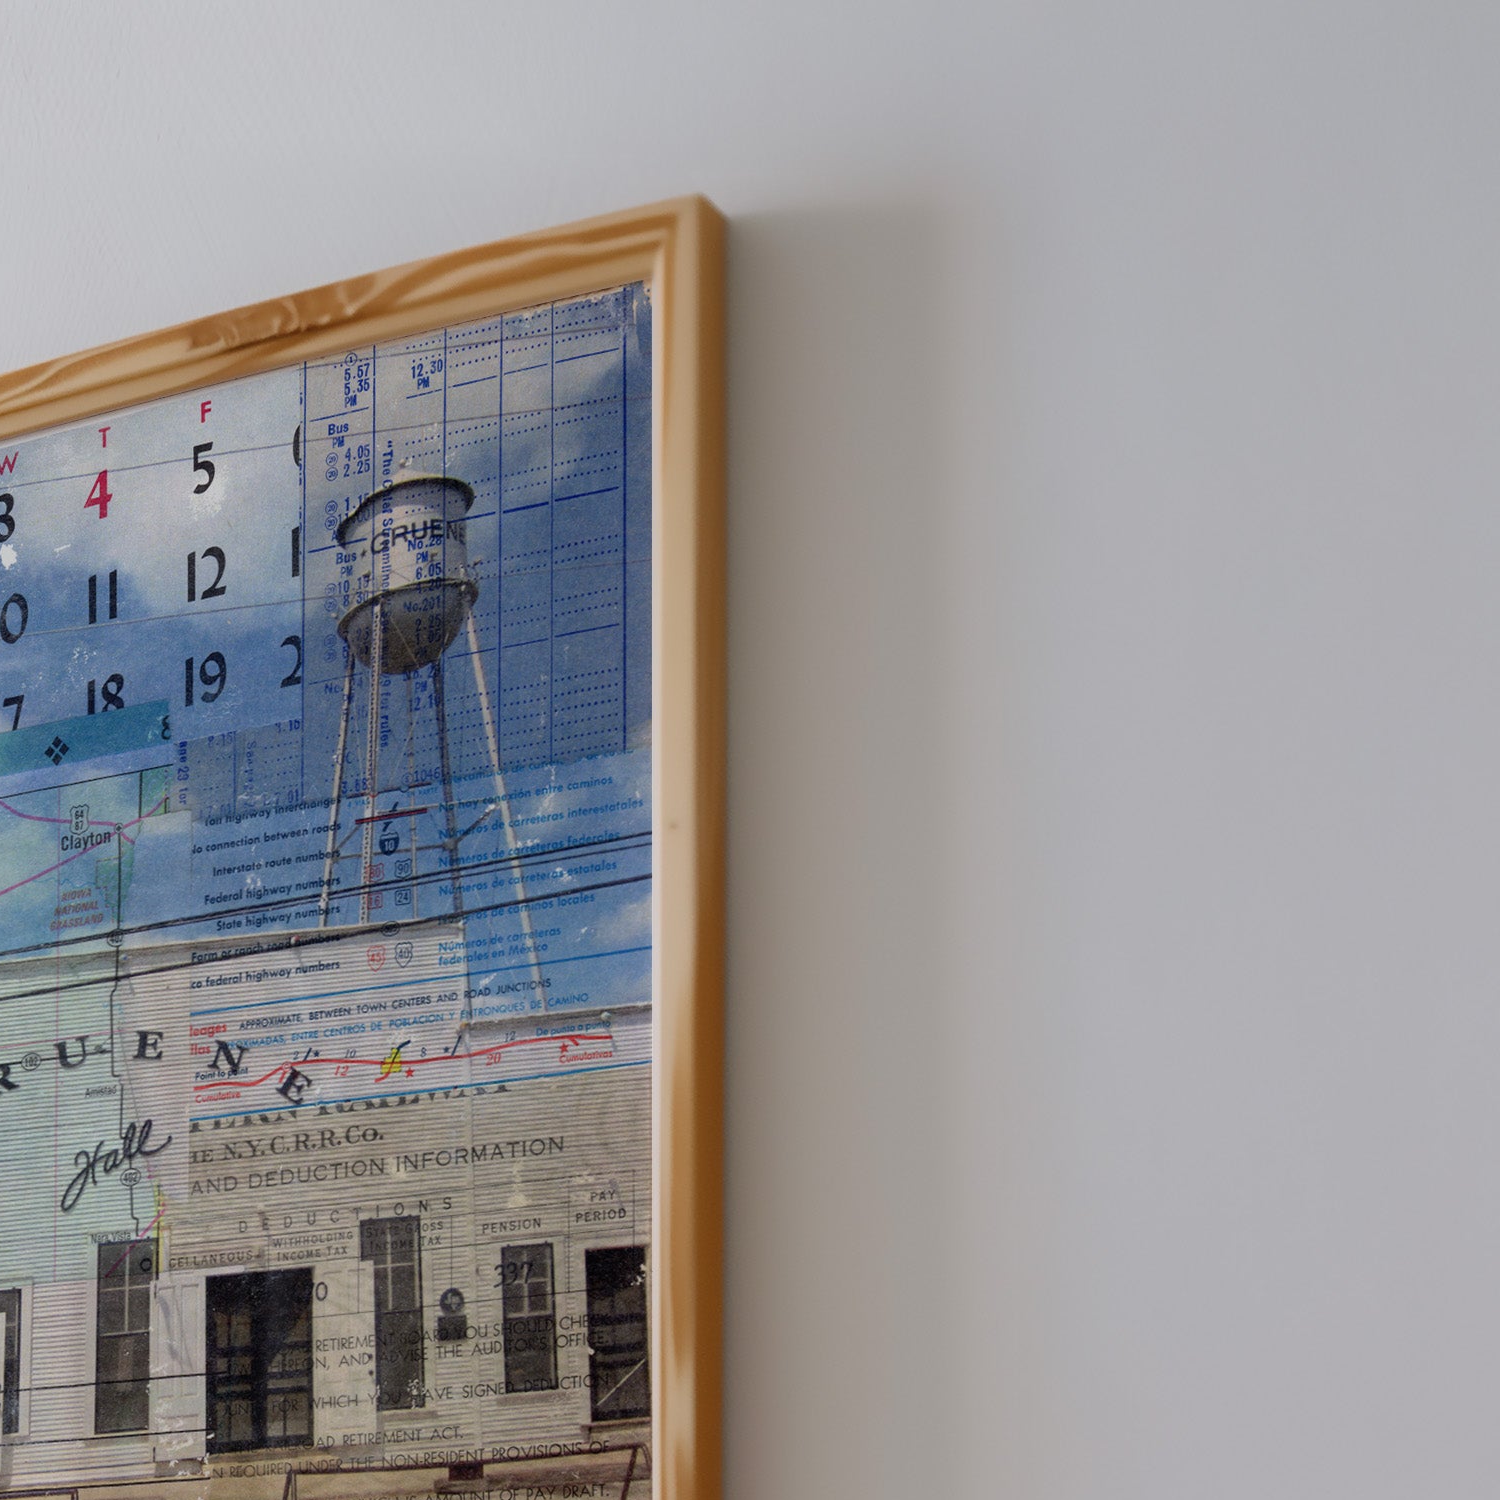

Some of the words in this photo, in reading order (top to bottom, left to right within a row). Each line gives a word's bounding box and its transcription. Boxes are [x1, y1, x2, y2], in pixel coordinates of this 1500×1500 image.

[411, 359, 443, 379] 12.30
[98, 427, 110, 448] T
[200, 400, 212, 423] F
[328, 422, 349, 436] Bus
[84, 470, 113, 520] 4
[192, 442, 215, 495] 5
[370, 518, 467, 554] GRUENE
[88, 569, 119, 625] 11
[187, 546, 227, 603] 12
[87, 673, 125, 716] 18
[185, 652, 227, 707] 19
[567, 775, 614, 791] caminos
[508, 812, 565, 827] carreteras
[568, 797, 645, 818] interestatales
[61, 831, 112, 852] Clayton
[205, 836, 261, 852] connection
[264, 829, 308, 843] between
[312, 822, 341, 834] roads
[213, 861, 262, 877] Interstate
[265, 857, 292, 868] route
[295, 849, 341, 863] numbers
[204, 889, 243, 906] Federal
[246, 881, 294, 900] highway
[295, 877, 341, 891] numbers
[216, 919, 244, 931] State
[246, 910, 293, 928] highway
[295, 904, 341, 919] numbers
[205, 973, 243, 988] federal
[245, 968, 292, 985] highway
[295, 961, 341, 976] numbers
[308, 1007, 351, 1021] BETWEEN
[356, 1001, 387, 1014] TOWN
[391, 994, 434, 1009] CENTERS
[436, 992, 459, 1003] AND
[463, 987, 491, 999] ROAD
[496, 978, 552, 994] JUNCTIONS
[291, 1030, 319, 1041] ENTRE
[323, 1023, 366, 1037] CENTROS
[370, 1021, 383, 1031] DE
[530, 999, 543, 1010] DE
[547, 993, 589, 1007] CAMINO
[551, 1024, 576, 1036] punto
[195, 1071, 216, 1081] Point
[195, 1090, 241, 1104] Cumulative
[61, 1119, 173, 1212] Hall
[190, 1176, 238, 1196] AND
[248, 1158, 385, 1190] DEDUCTION
[396, 1136, 565, 1173] INFORMATION
[590, 1189, 616, 1202] PAY
[482, 1218, 542, 1234] PENSION
[575, 1208, 627, 1223] PERIOD
[273, 1231, 353, 1248] WITHHOLDING
[277, 1249, 321, 1262] INCOME
[339, 1353, 372, 1368] AND
[437, 1344, 463, 1359] THE
[343, 1429, 422, 1446] RETIREMENT
[430, 1426, 464, 1441] ACT.
[492, 1442, 582, 1461] PROVISIONS
[526, 1486, 556, 1500] PAY
[562, 1483, 610, 1499] DRAFT.
